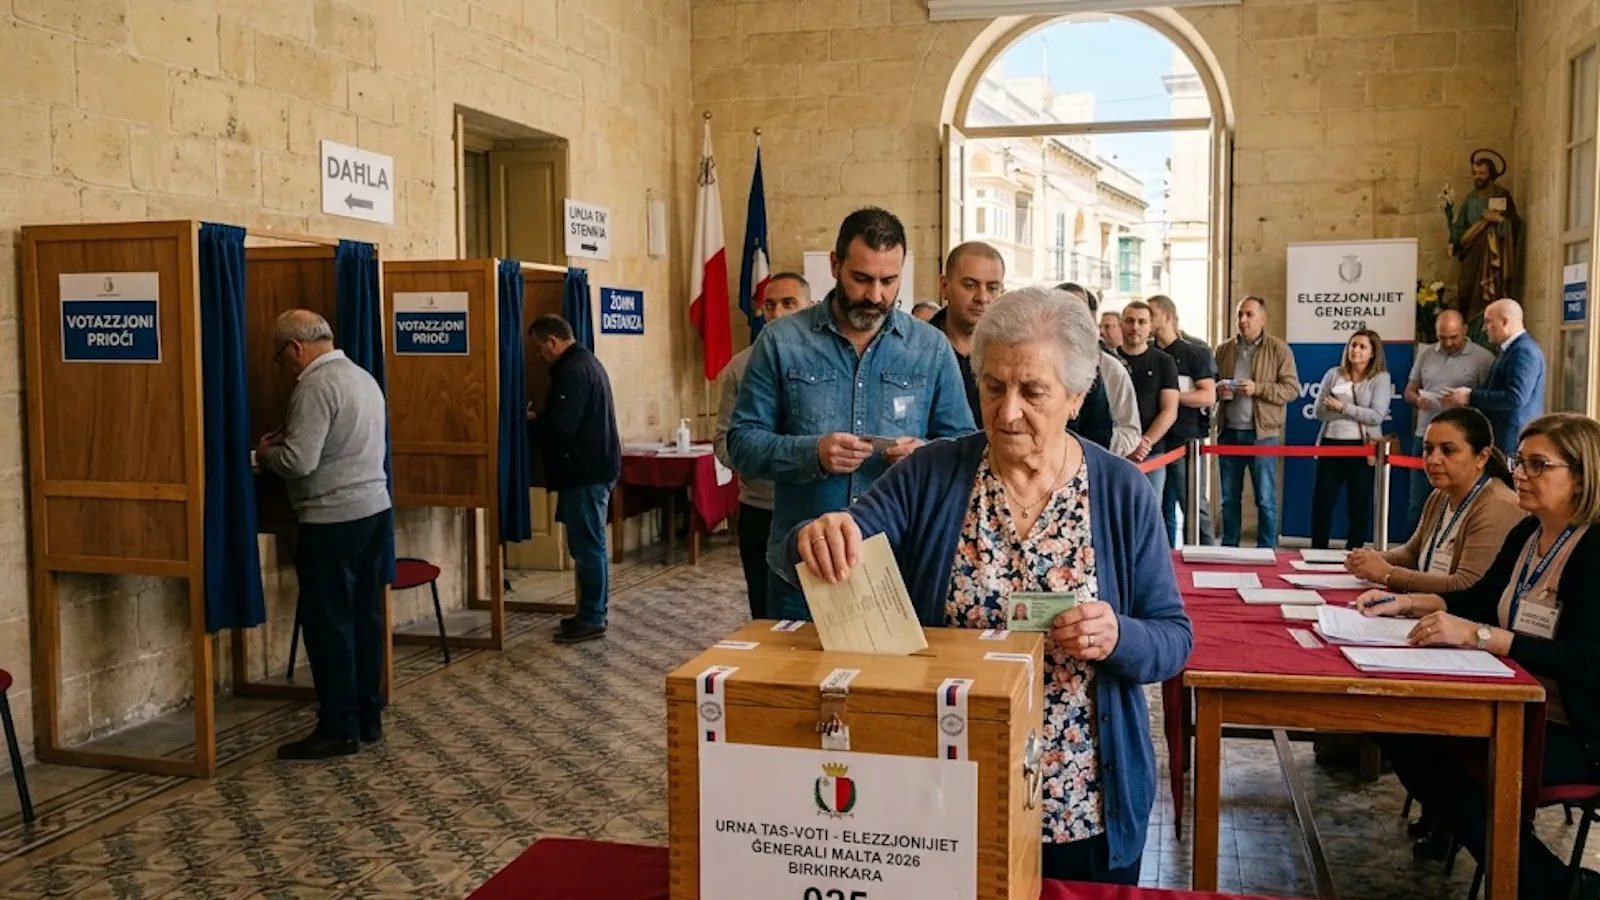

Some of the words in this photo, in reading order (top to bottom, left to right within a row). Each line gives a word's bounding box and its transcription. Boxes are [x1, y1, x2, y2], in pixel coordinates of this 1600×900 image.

[1297, 292, 1404, 303] ELEZZJONIJIET
[66, 314, 154, 329] VOTAZZJONI
[397, 320, 464, 331] VOTAZZJONI
[716, 819, 757, 834] URNA
[761, 823, 828, 841] TAS-VOTI
[843, 830, 959, 852] ELEZZJONIJIET
[832, 848, 882, 864] MALTA
[886, 853, 920, 867] 2026
[788, 861, 883, 882] BIRKIRKARA
